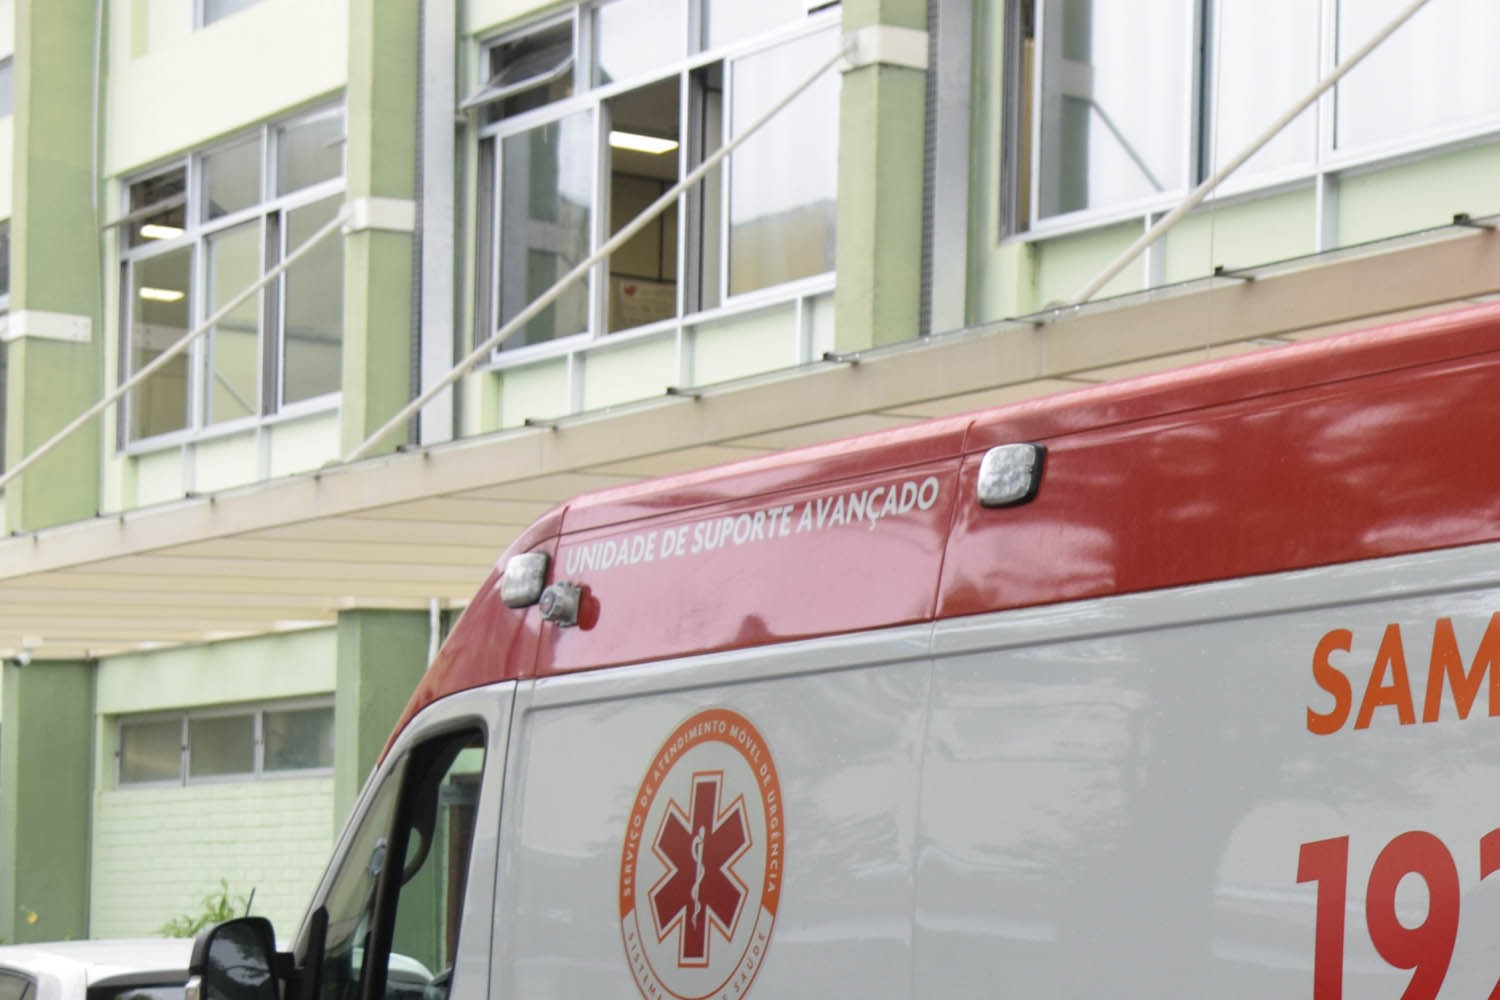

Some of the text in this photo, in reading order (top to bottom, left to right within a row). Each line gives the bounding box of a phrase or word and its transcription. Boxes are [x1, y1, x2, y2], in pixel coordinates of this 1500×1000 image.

[565, 476, 940, 576] UNIDADE DE SUPORTE AVANÇADO
[652, 720, 726, 783] ATENDIMENTO
